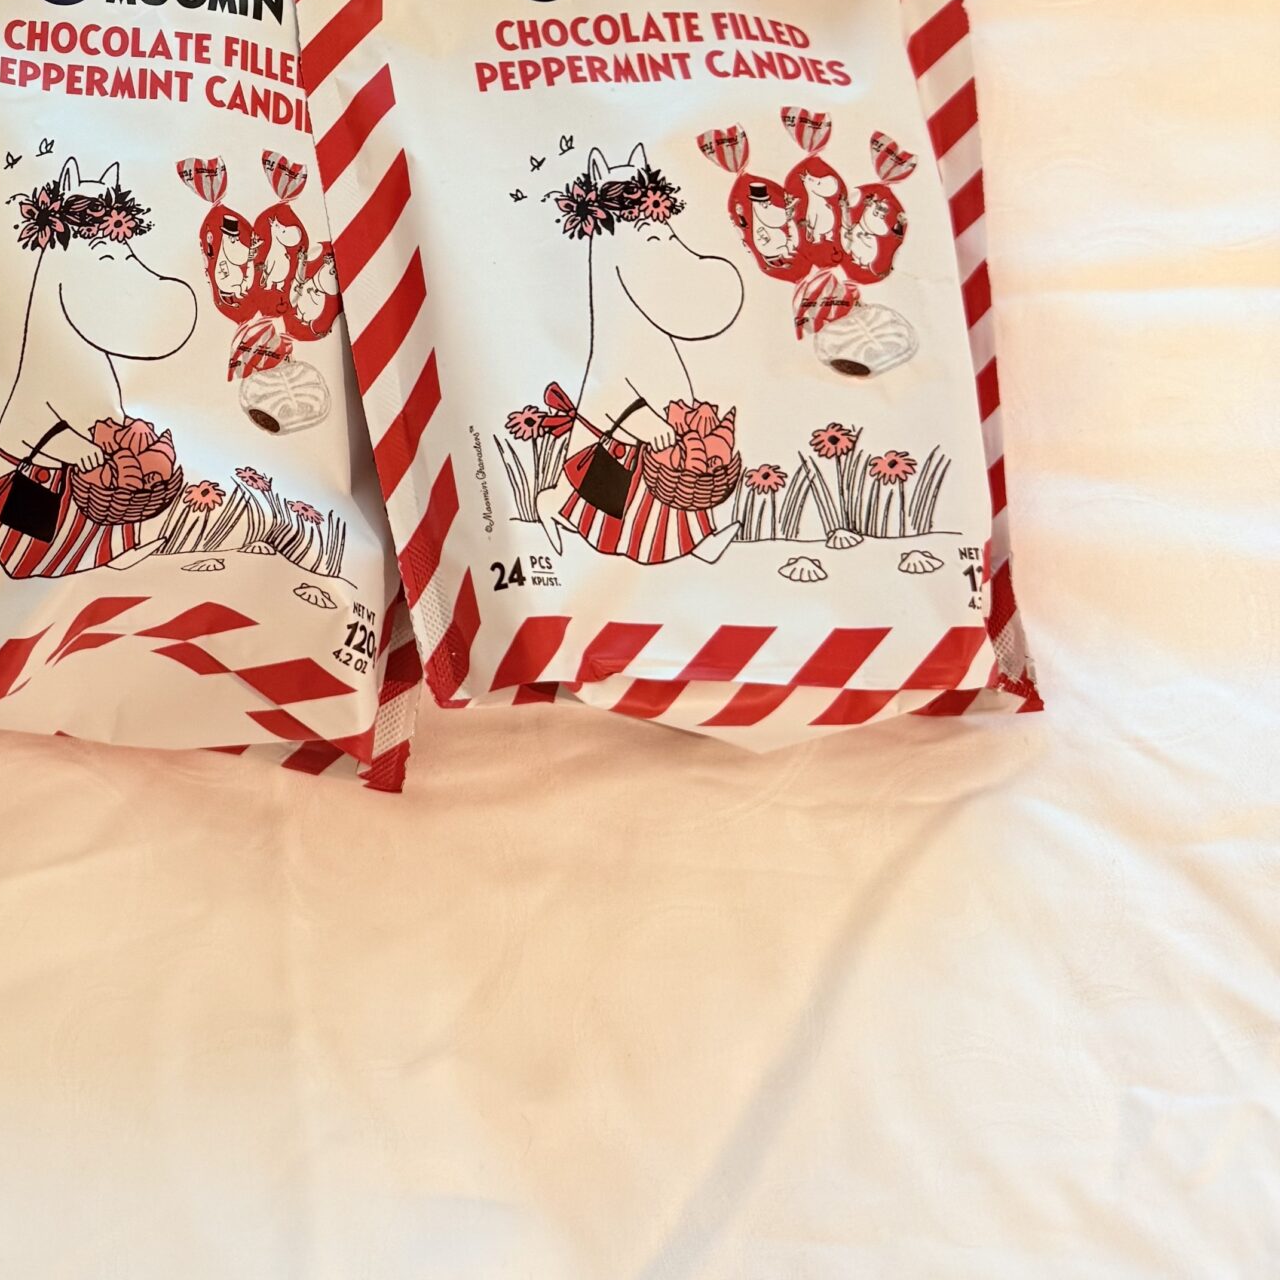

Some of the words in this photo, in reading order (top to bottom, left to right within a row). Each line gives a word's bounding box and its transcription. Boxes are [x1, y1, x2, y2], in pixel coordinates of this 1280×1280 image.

[4, 19, 212, 65] CHOCOLATE
[495, 11, 704, 51] CHOCOLATE
[710, 11, 809, 48] FILLED
[475, 52, 692, 92] PEPPERMINT
[705, 49, 852, 87] CANDIES
[205, 75, 313, 135] CANDI
[529, 555, 552, 570] PCS
[958, 547, 979, 560] NET
[490, 556, 526, 592] 24
[352, 601, 365, 619] NET
[332, 648, 353, 667] 4.2
[344, 620, 377, 663] 120
